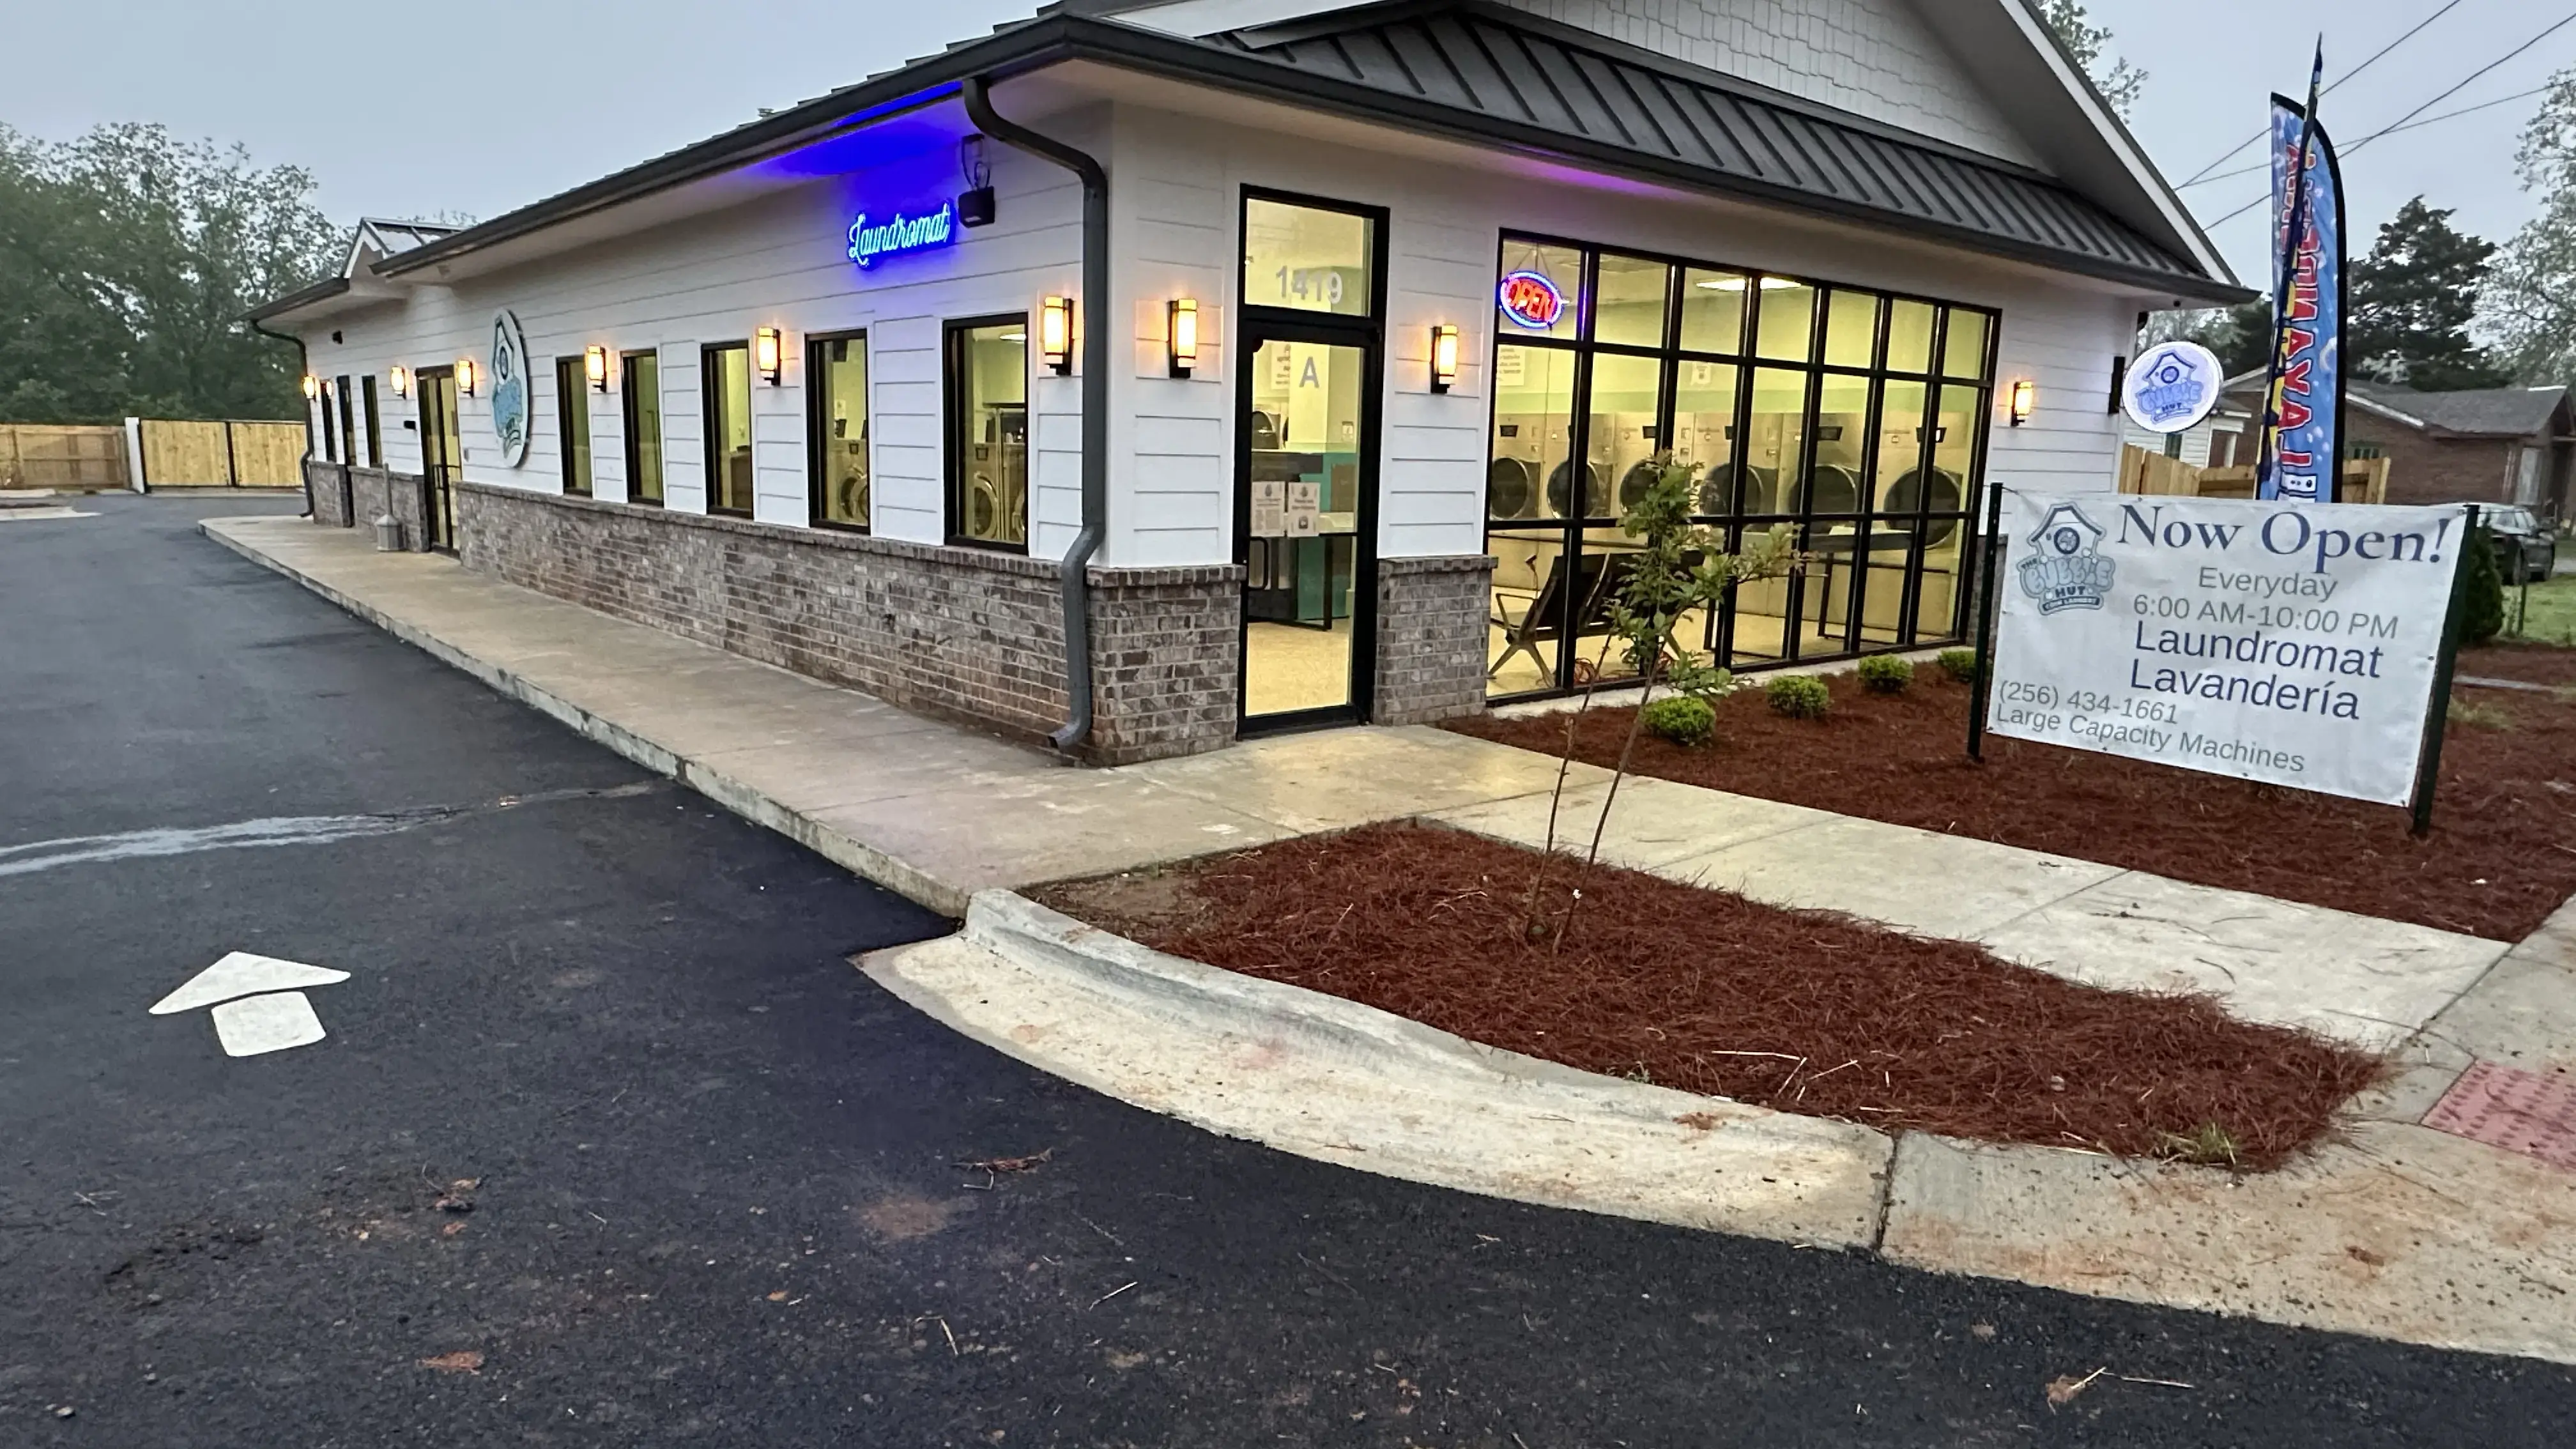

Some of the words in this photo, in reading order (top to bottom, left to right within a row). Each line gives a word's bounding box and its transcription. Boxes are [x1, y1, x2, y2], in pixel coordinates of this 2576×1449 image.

[848, 202, 951, 266] Laundromat
[1276, 265, 1343, 304] 1419
[1505, 279, 1556, 322] OPEN
[1299, 356, 1319, 388] A
[2117, 503, 2244, 551] Now
[2261, 510, 2451, 574] Open!
[2024, 557, 2110, 594] BUBBLE
[2055, 585, 2085, 598] HUT
[2198, 565, 2338, 603] Everyday
[2133, 594, 2190, 620] 6:00
[2348, 613, 2399, 639] PM
[2135, 620, 2384, 678] Laundromat
[1998, 679, 2059, 710] (256)
[2067, 690, 2179, 725] 434-1661
[2131, 658, 2359, 720] Lavandería
[1996, 704, 2062, 733] Large
[2069, 715, 2172, 752] Capacity
[2179, 732, 2305, 772] Machines
